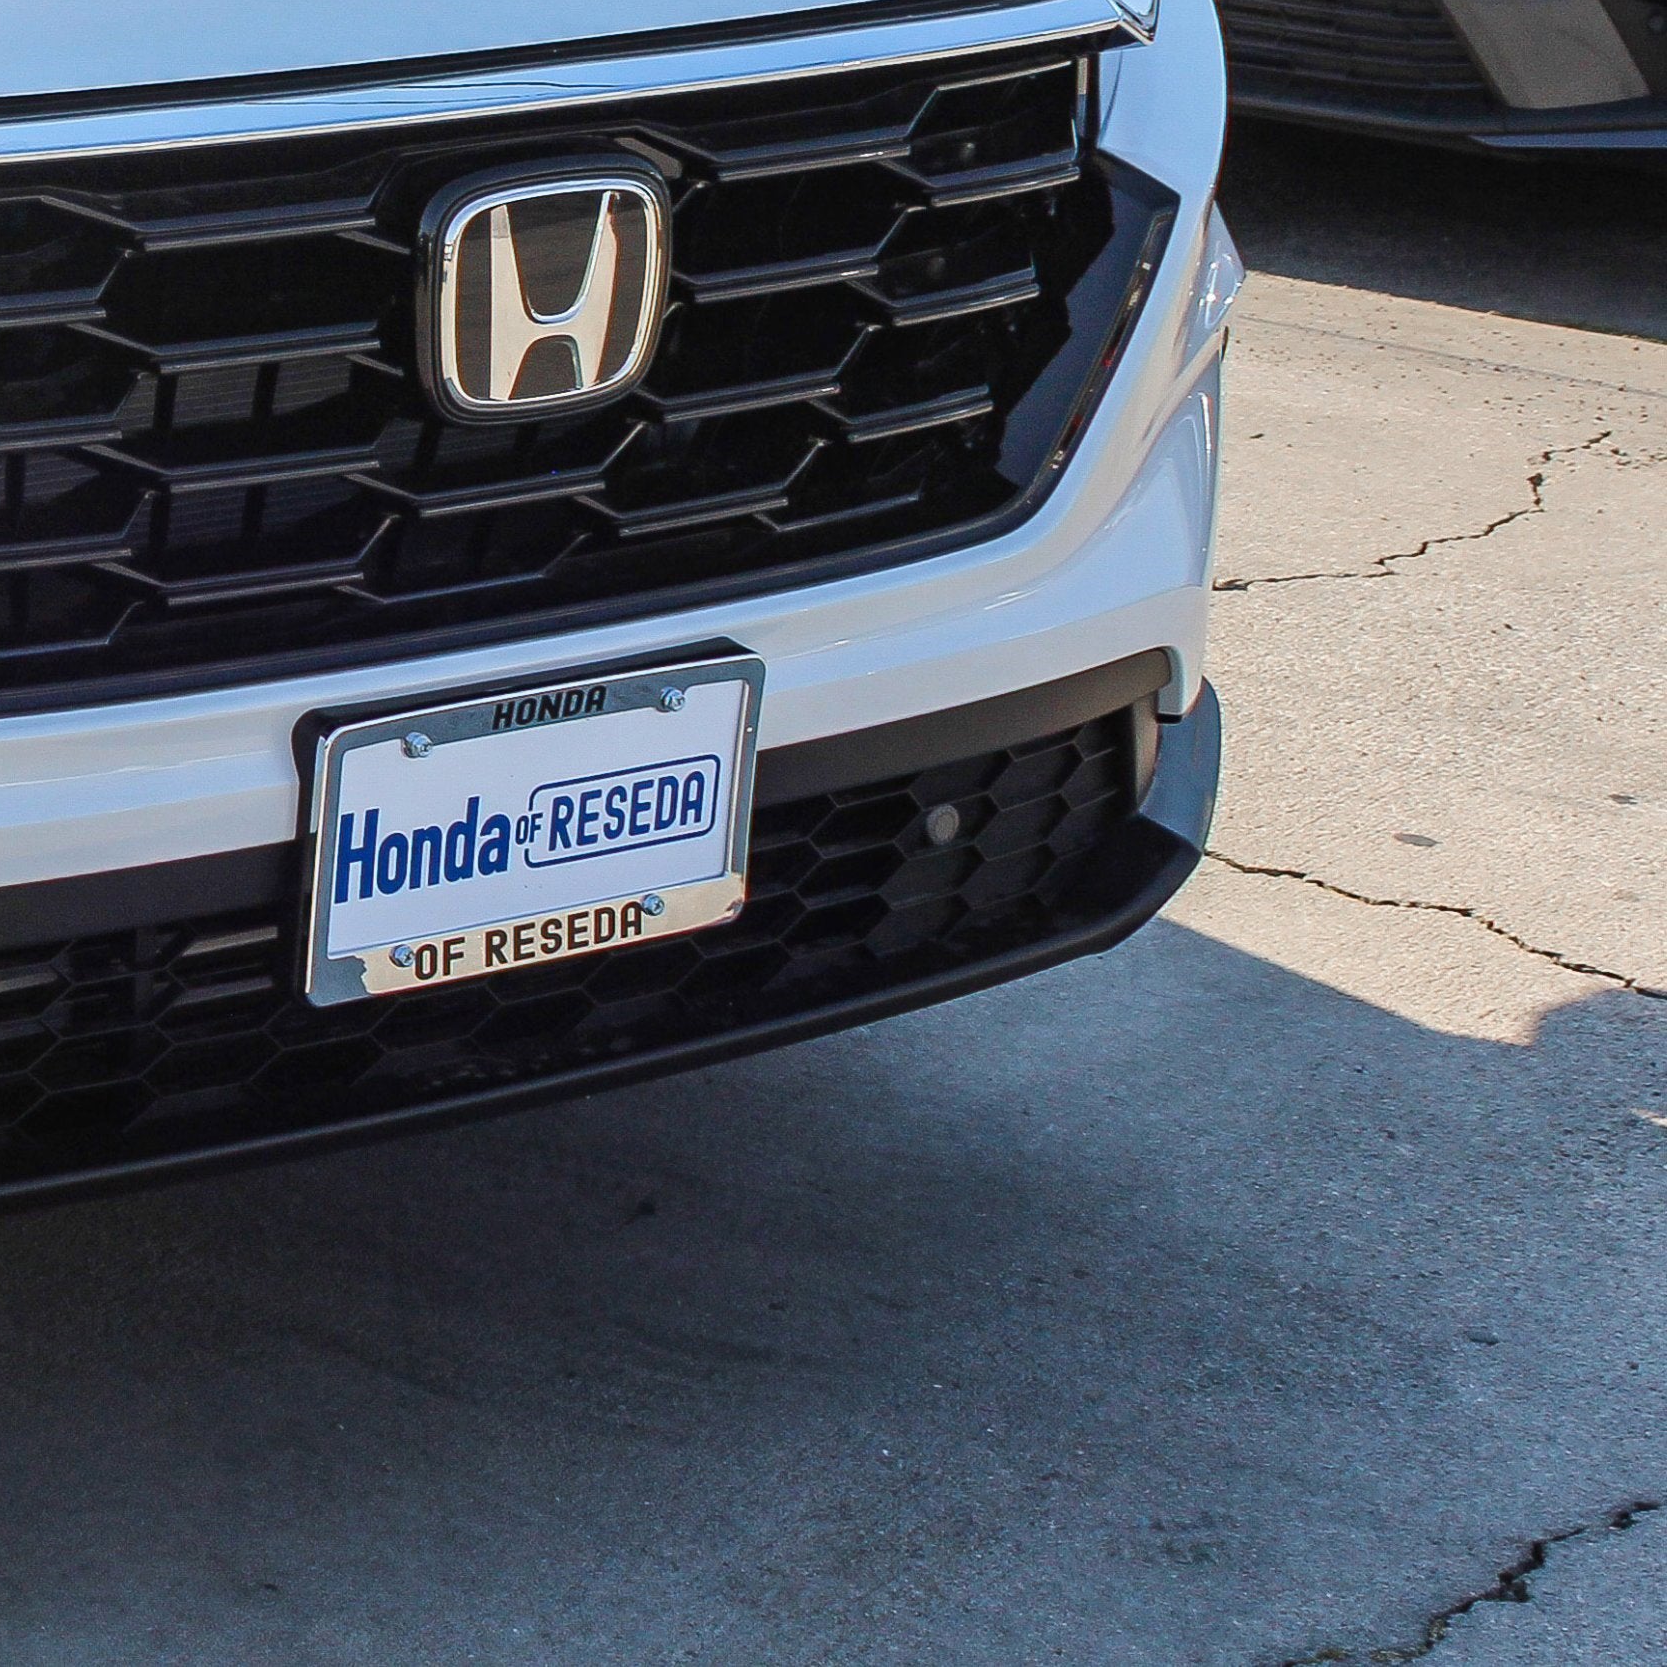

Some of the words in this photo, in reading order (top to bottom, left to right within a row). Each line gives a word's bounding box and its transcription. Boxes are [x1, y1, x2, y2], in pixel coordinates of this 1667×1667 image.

[492, 686, 607, 730] HONDA
[334, 797, 511, 904] Honda
[515, 812, 544, 845] OF
[548, 770, 706, 852] RESEDA
[414, 936, 466, 981] OF
[484, 900, 643, 968] RESEDA
